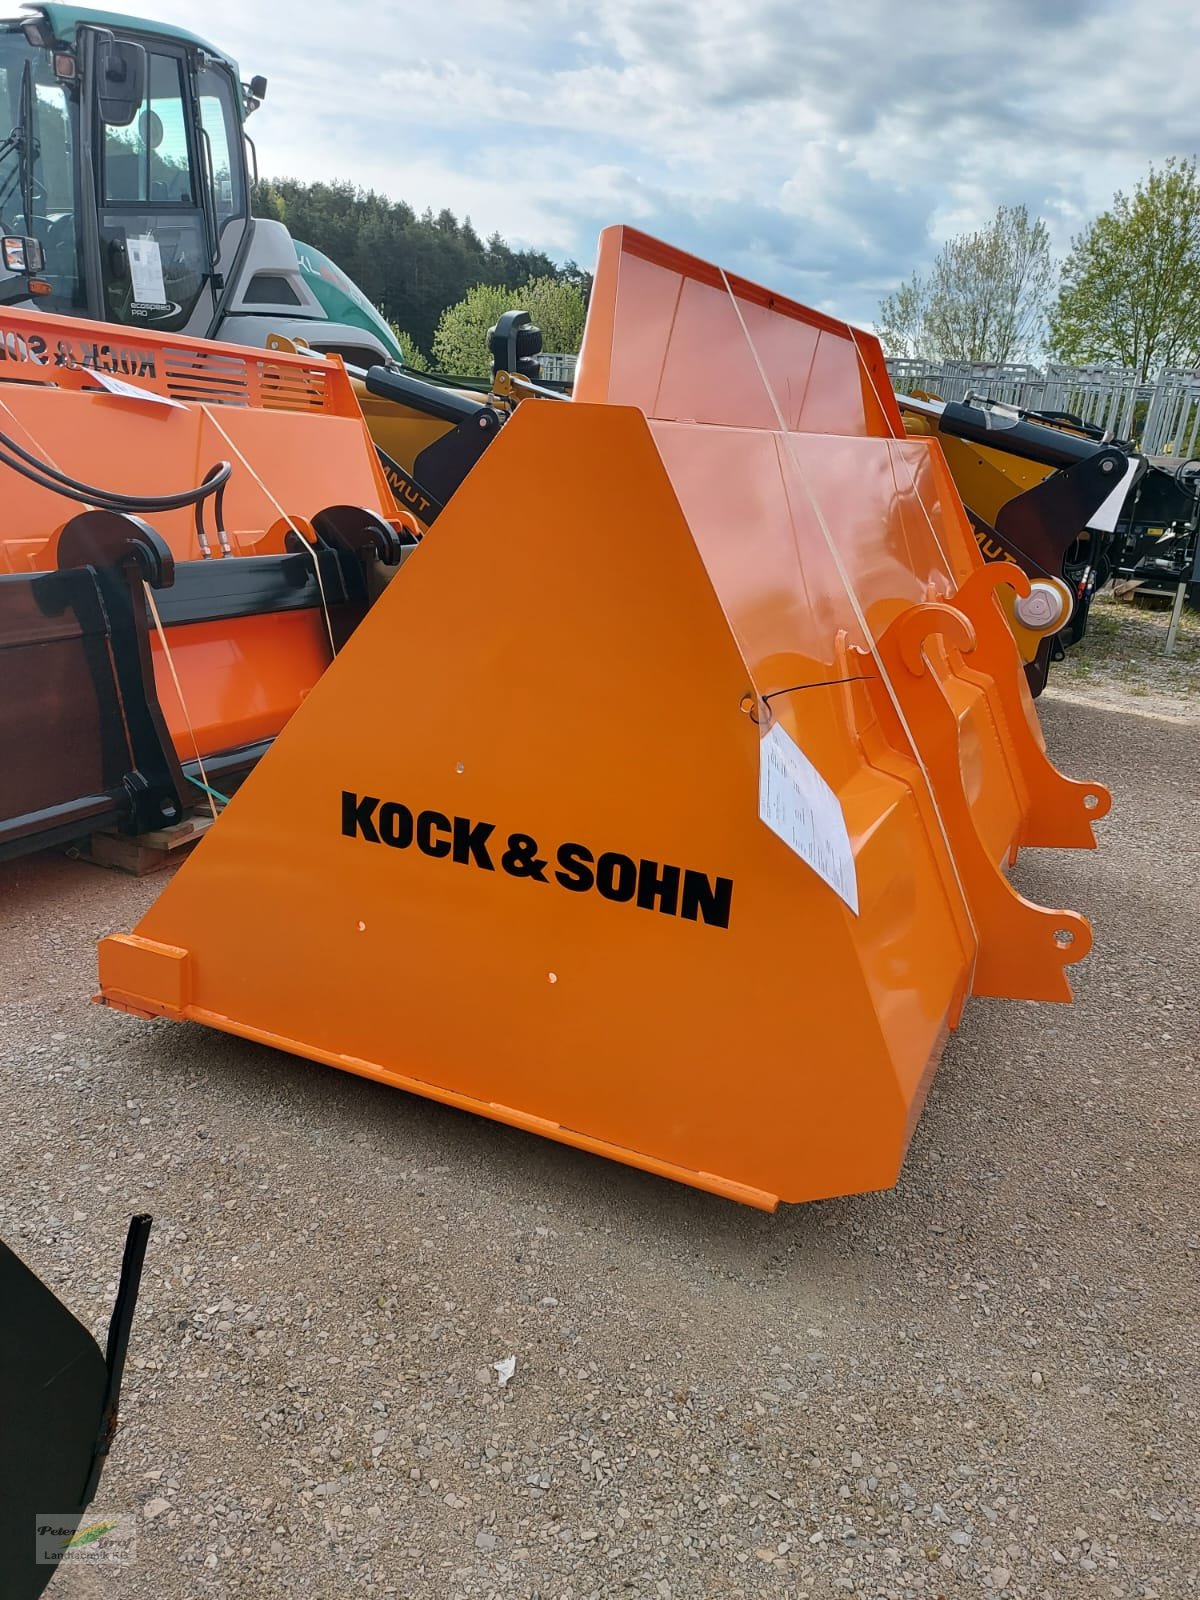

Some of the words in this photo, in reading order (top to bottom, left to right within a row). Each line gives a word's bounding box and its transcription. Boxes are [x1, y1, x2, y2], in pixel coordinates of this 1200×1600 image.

[130, 302, 171, 311] ecospeed
[341, 790, 497, 872] KOCK
[501, 833, 550, 884] &
[554, 842, 734, 930] SOHN
